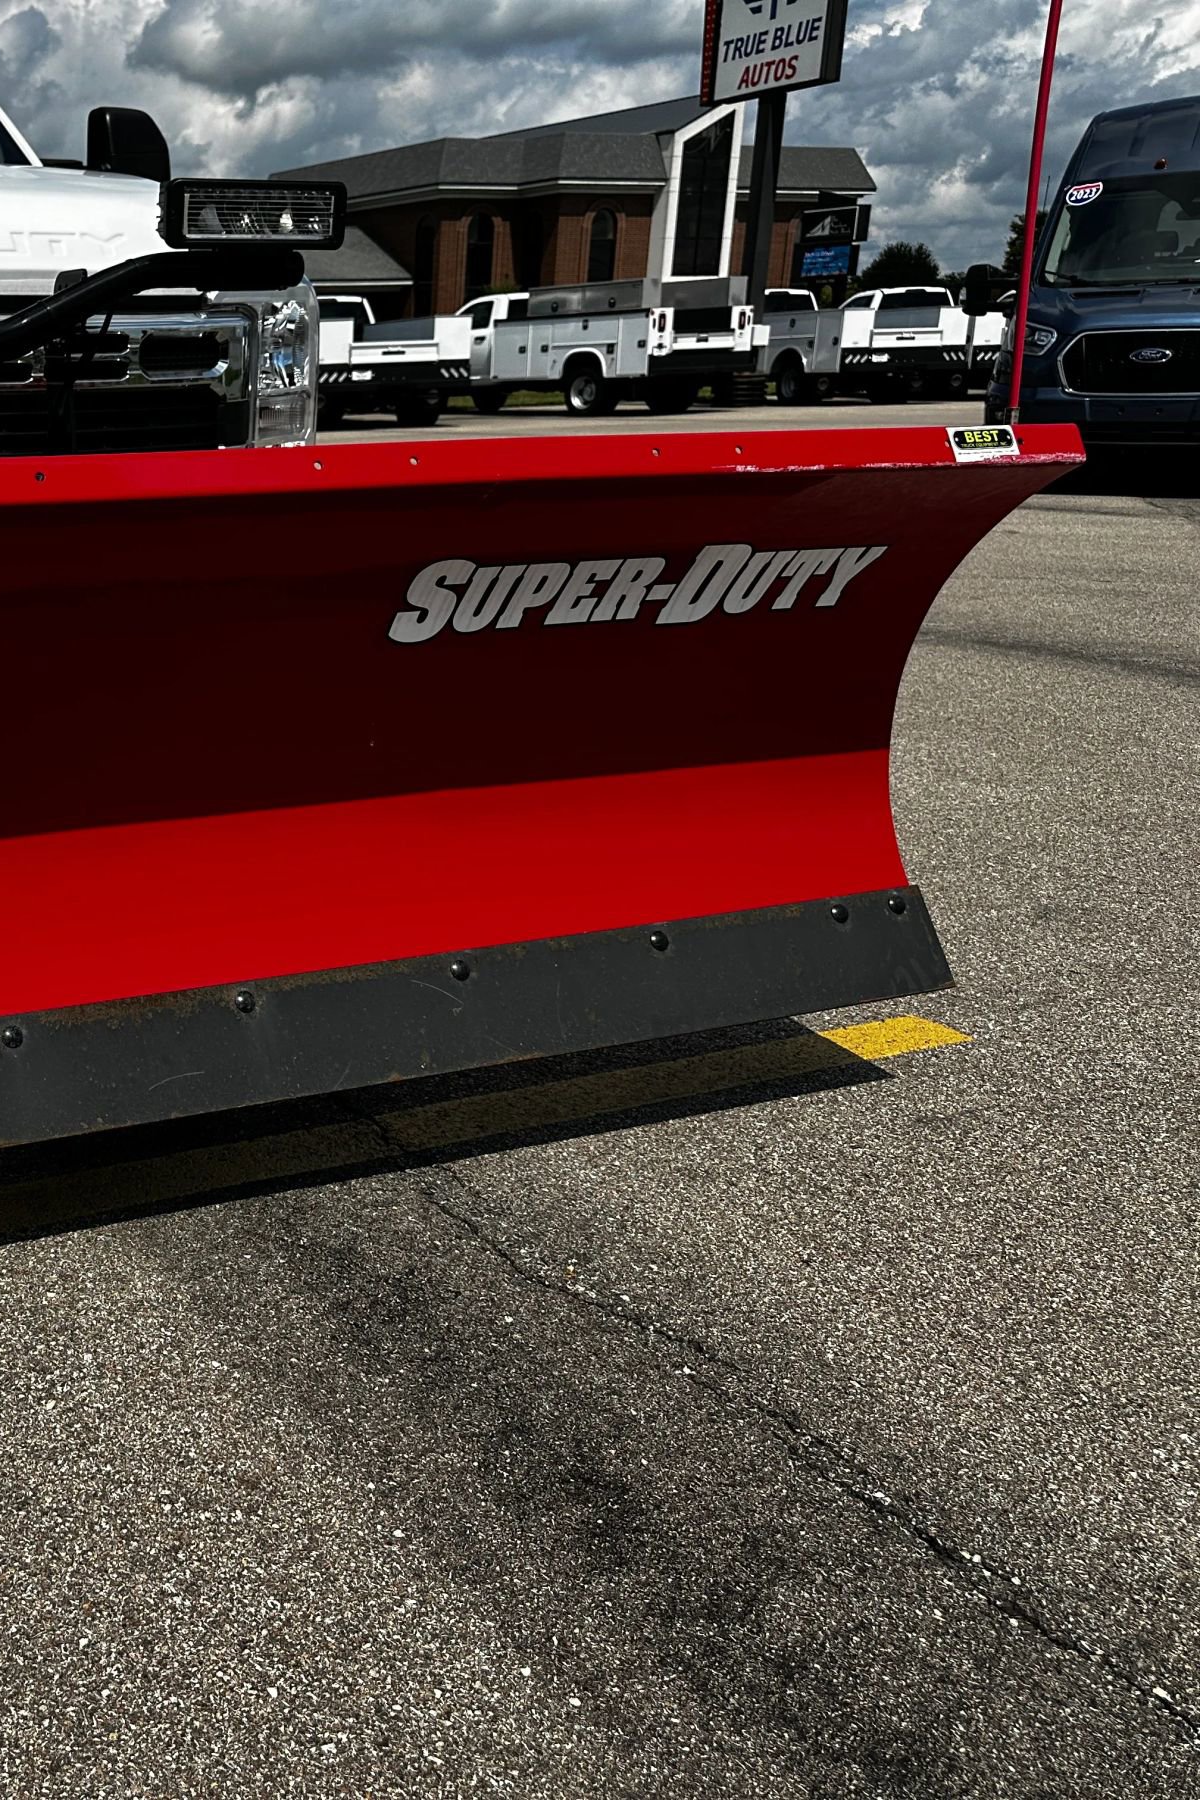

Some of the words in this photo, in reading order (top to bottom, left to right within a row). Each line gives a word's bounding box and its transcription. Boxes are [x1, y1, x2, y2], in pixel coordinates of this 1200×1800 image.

[723, 30, 769, 63] TRUE
[770, 16, 823, 51] BLUE
[737, 55, 799, 90] AUTOS
[1070, 187, 1097, 201] 2023
[964, 430, 999, 443] BEST
[388, 543, 888, 643] SUPER-DUTY
